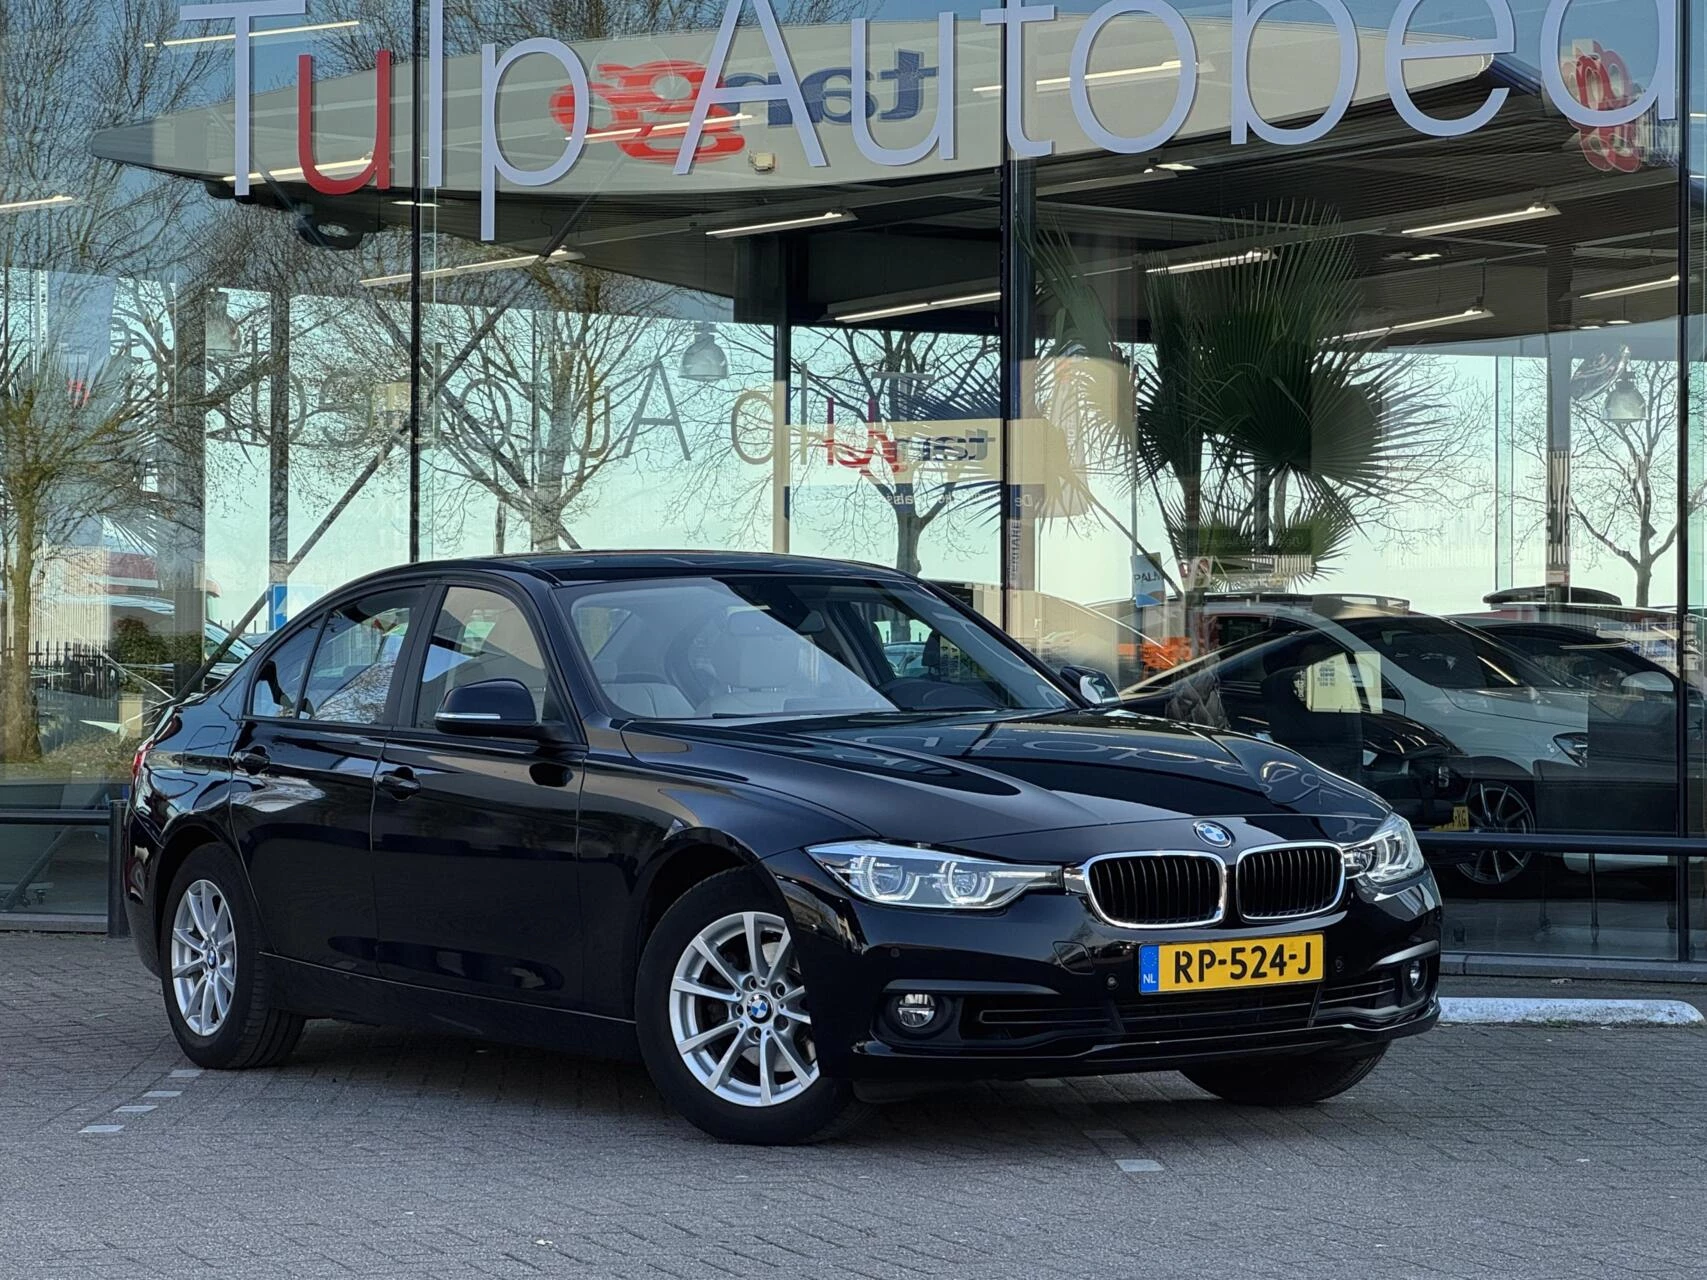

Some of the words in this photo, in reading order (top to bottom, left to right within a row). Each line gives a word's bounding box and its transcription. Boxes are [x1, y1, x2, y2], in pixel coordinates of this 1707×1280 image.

[180, 0, 588, 241] Tulp
[1143, 973, 1157, 984] NL
[1174, 941, 1312, 984] RP-524-J
